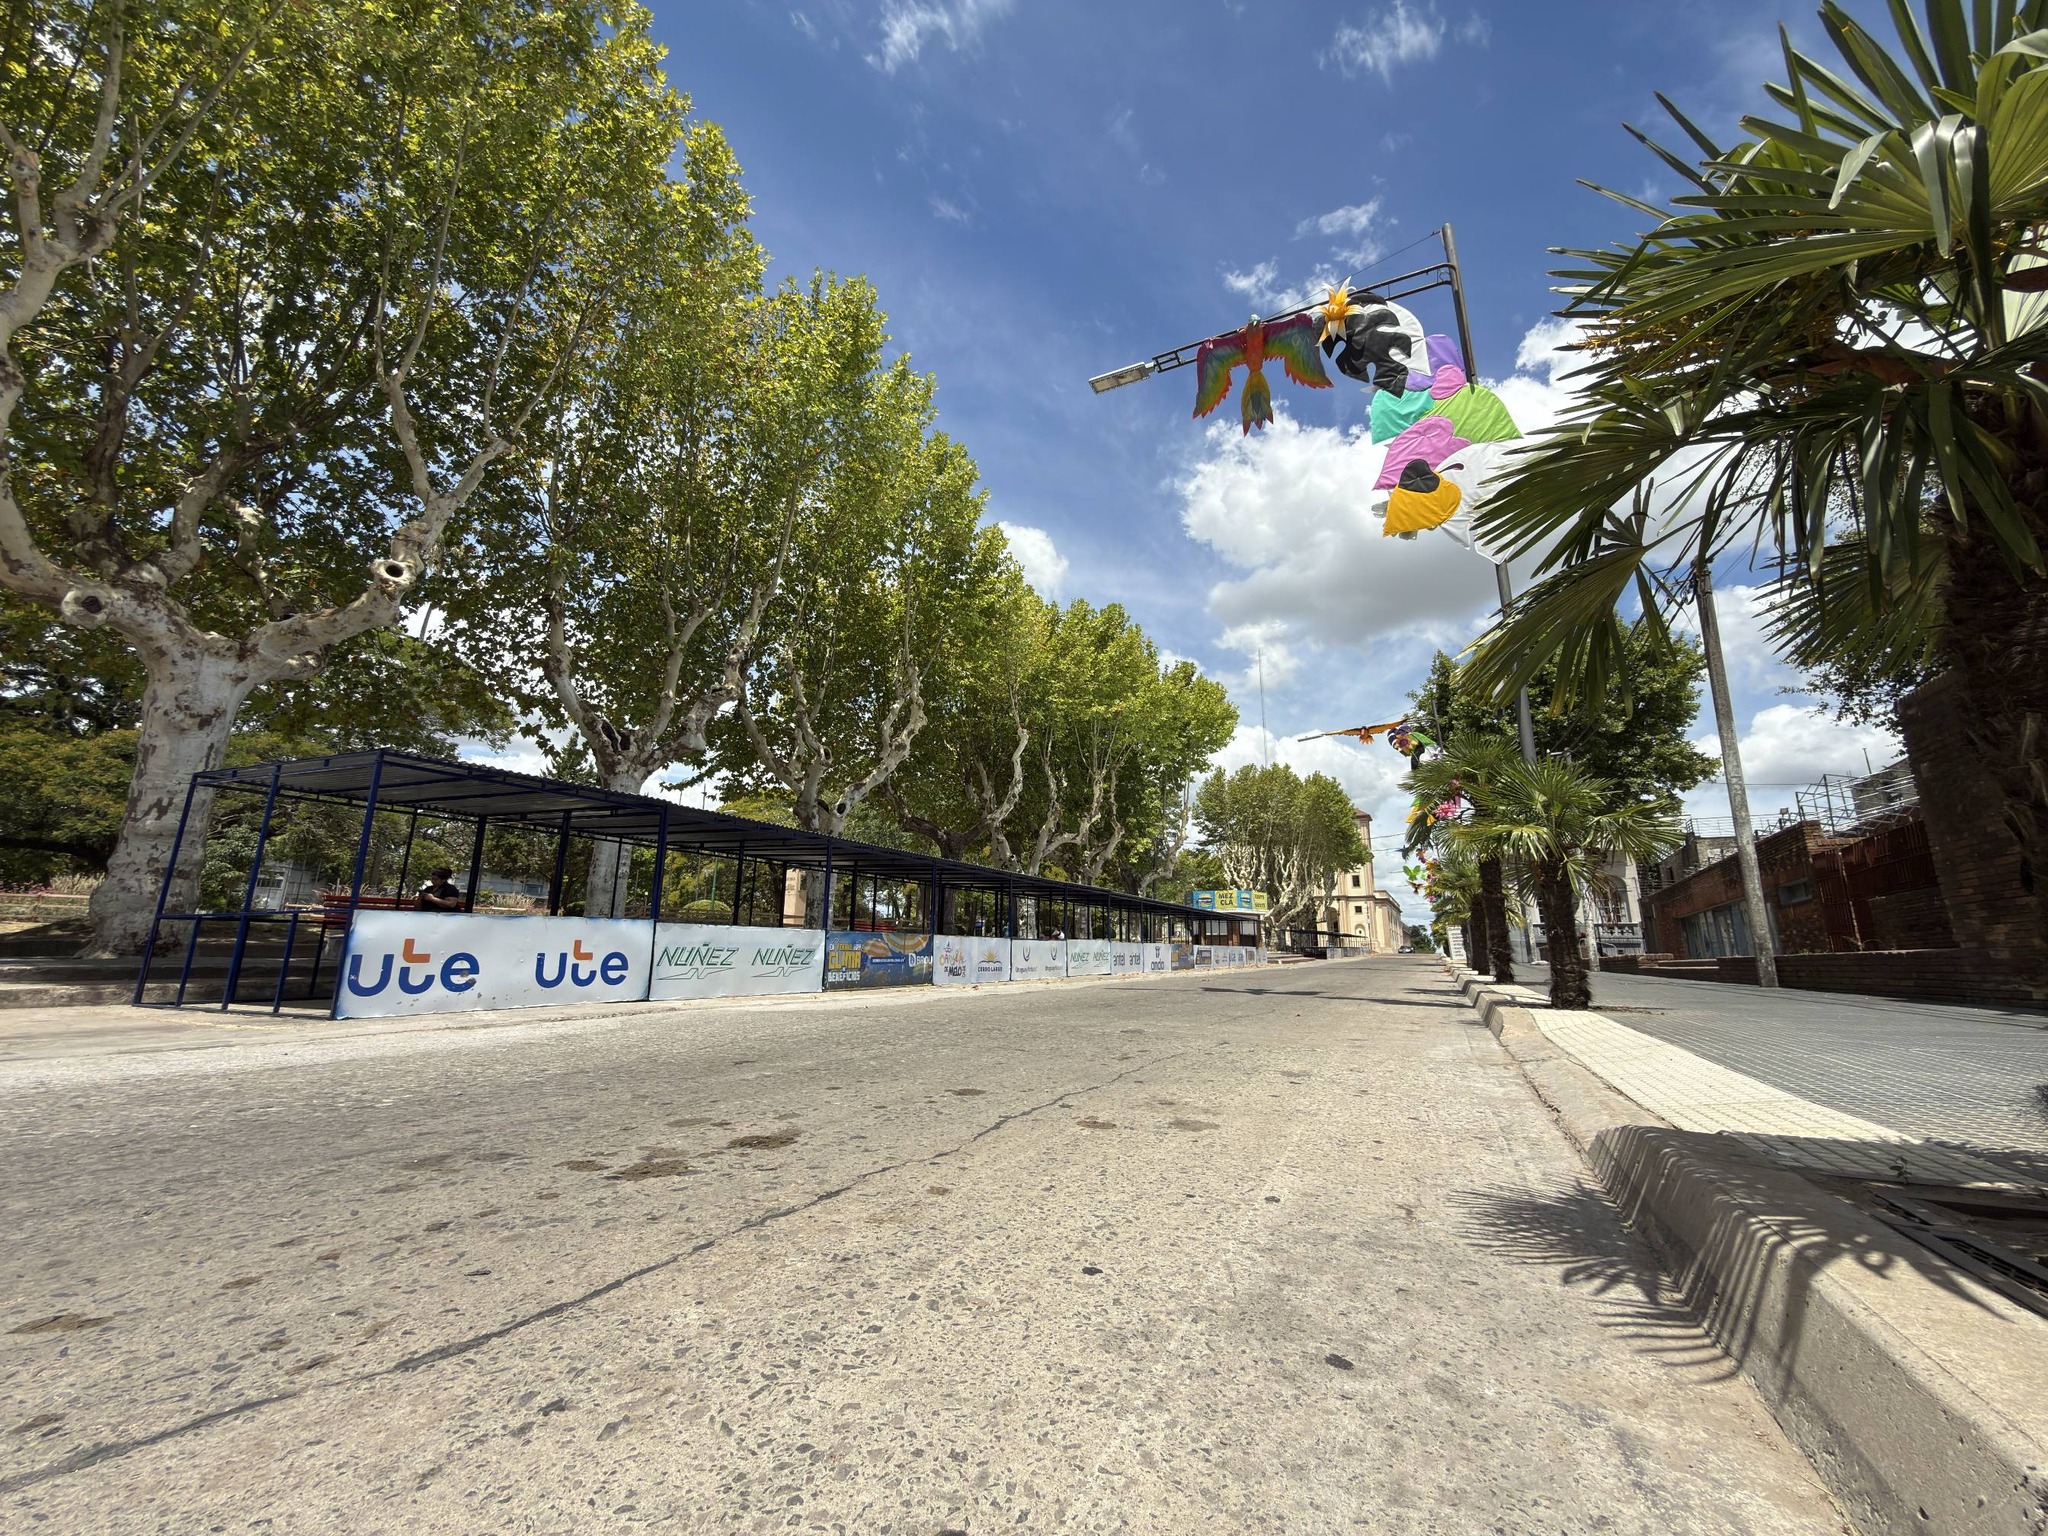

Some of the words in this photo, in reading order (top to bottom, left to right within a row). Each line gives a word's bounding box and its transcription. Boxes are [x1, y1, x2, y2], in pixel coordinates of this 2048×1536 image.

[535, 939, 629, 989] ute
[656, 942, 740, 966] NUÑEZ
[751, 944, 816, 966] NUÑEZ
[829, 951, 861, 969] CLIMA
[916, 955, 933, 965] BROU
[347, 938, 480, 997] ute
